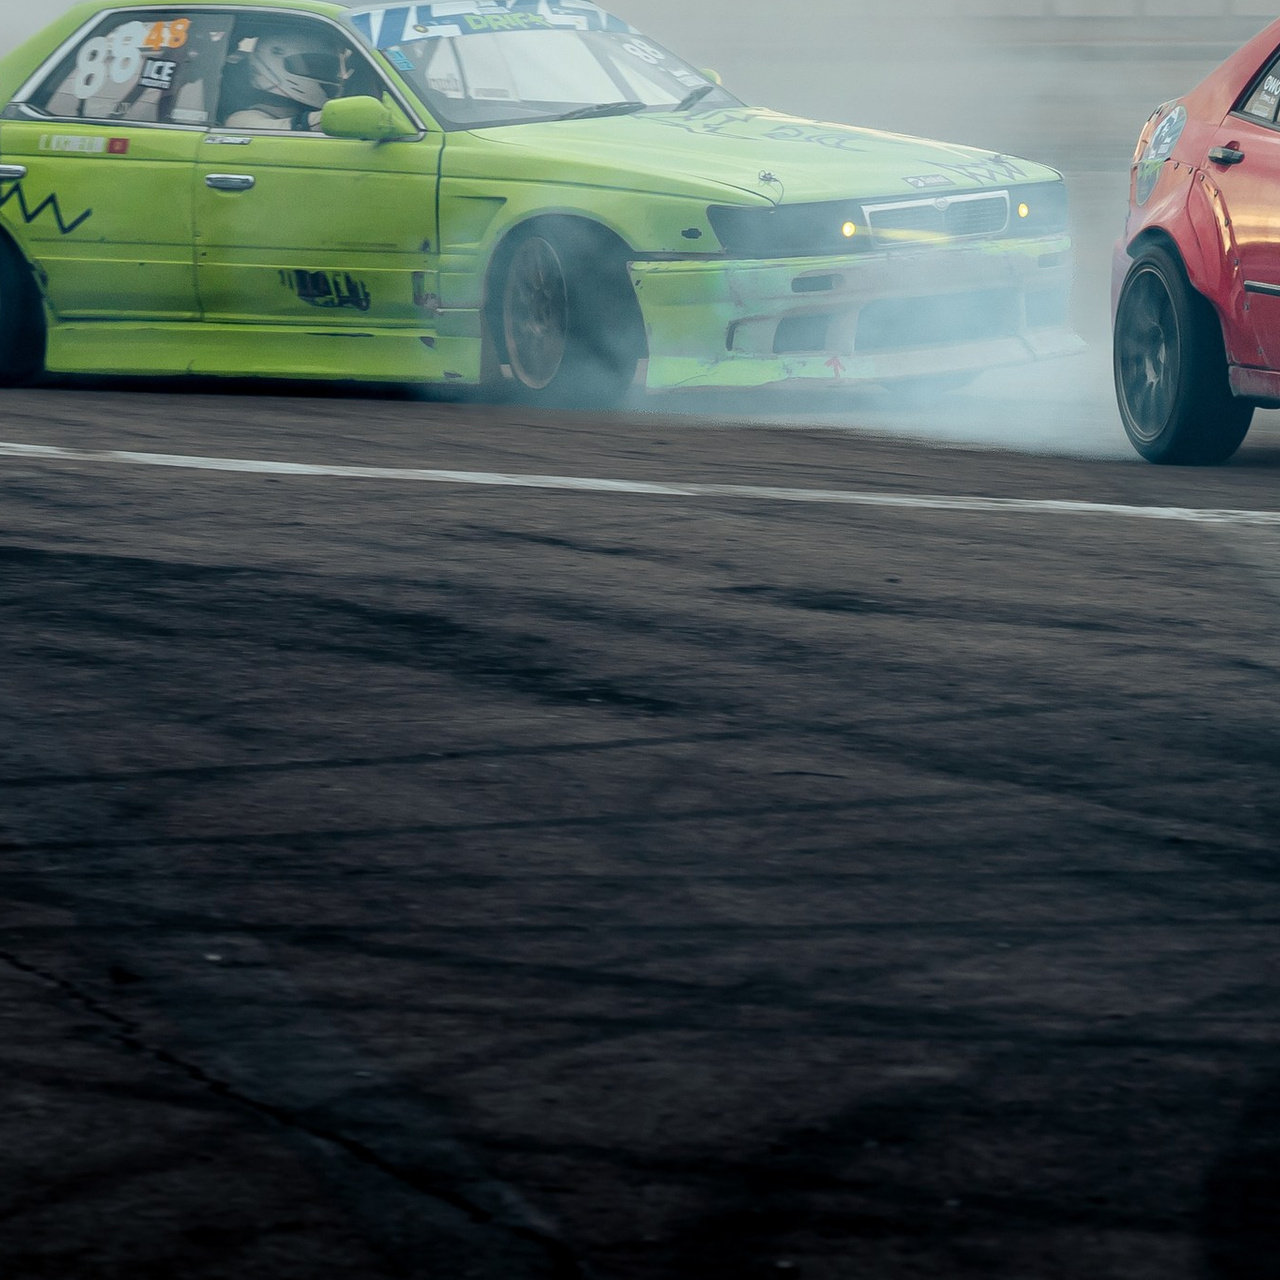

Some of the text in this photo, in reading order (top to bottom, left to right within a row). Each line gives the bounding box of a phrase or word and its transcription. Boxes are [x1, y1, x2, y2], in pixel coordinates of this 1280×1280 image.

[142, 18, 190, 50] 48
[464, 12, 553, 30] DRIFT
[74, 20, 142, 99] 88
[622, 38, 665, 65] 88
[141, 59, 177, 81] ICE
